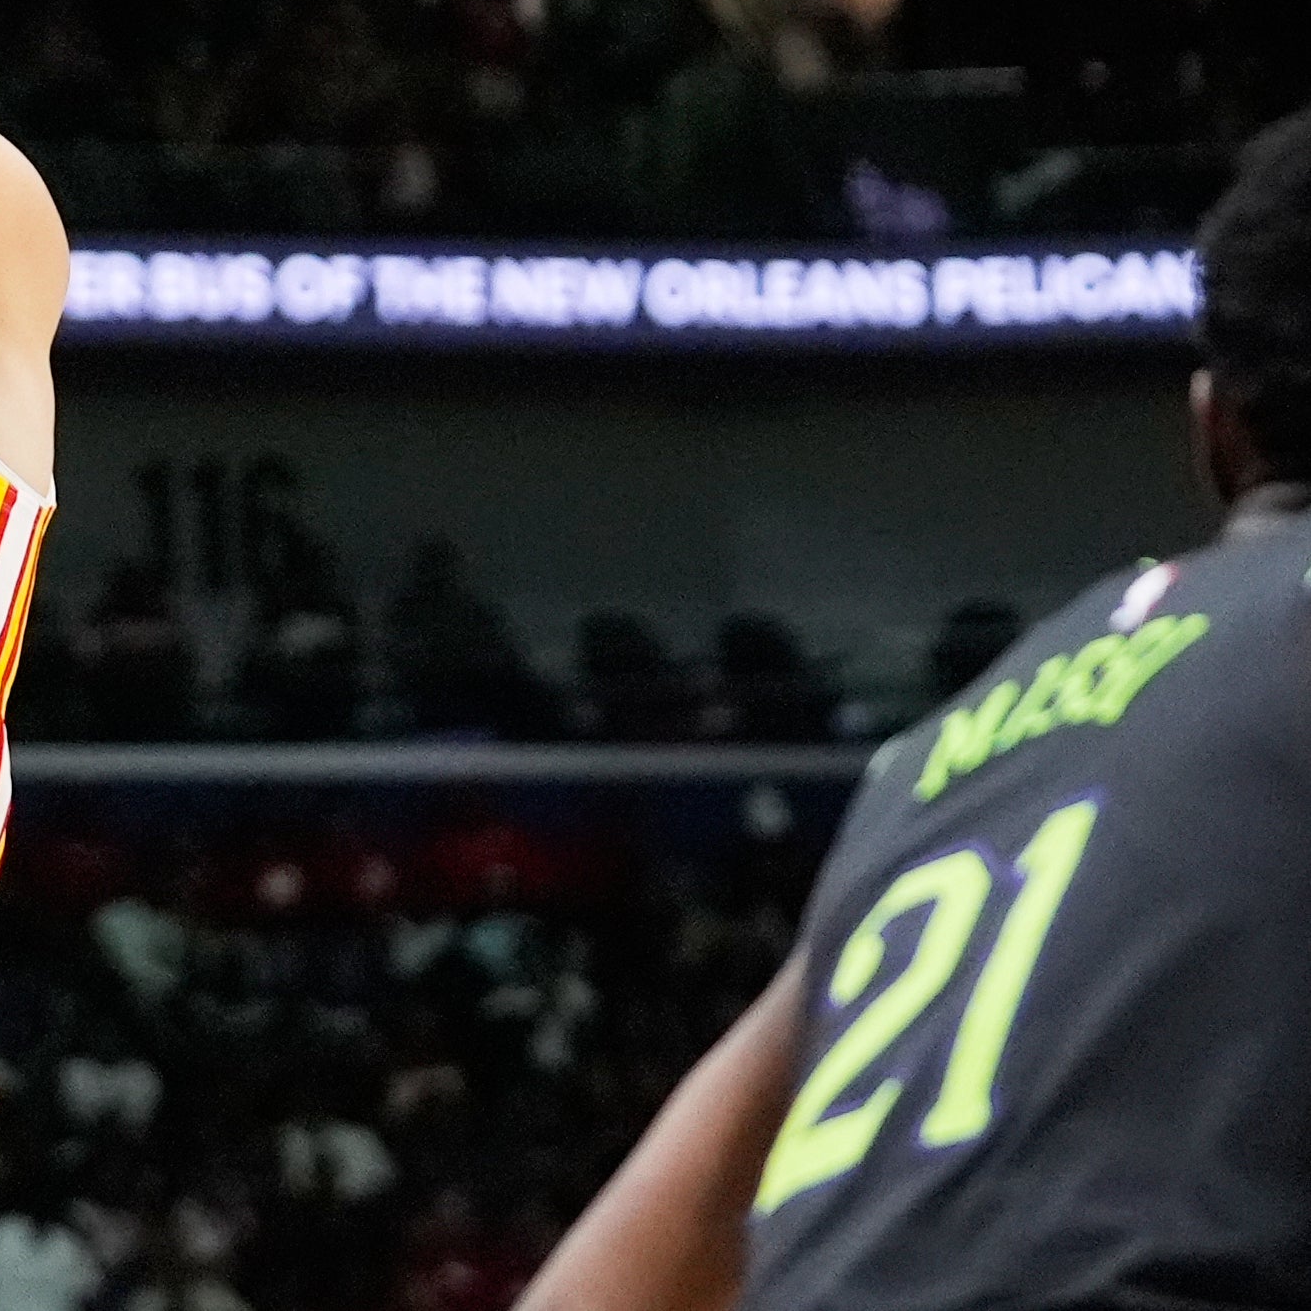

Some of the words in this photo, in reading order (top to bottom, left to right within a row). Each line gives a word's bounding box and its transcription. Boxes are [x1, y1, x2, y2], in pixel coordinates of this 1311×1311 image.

[147, 252, 272, 321] BUS
[276, 254, 366, 322] OF
[372, 256, 485, 325] THE
[490, 258, 641, 326] NEW
[643, 260, 929, 328] ORLEANS
[932, 252, 1200, 324] PELICAN
[753, 797, 1099, 1215] 21
